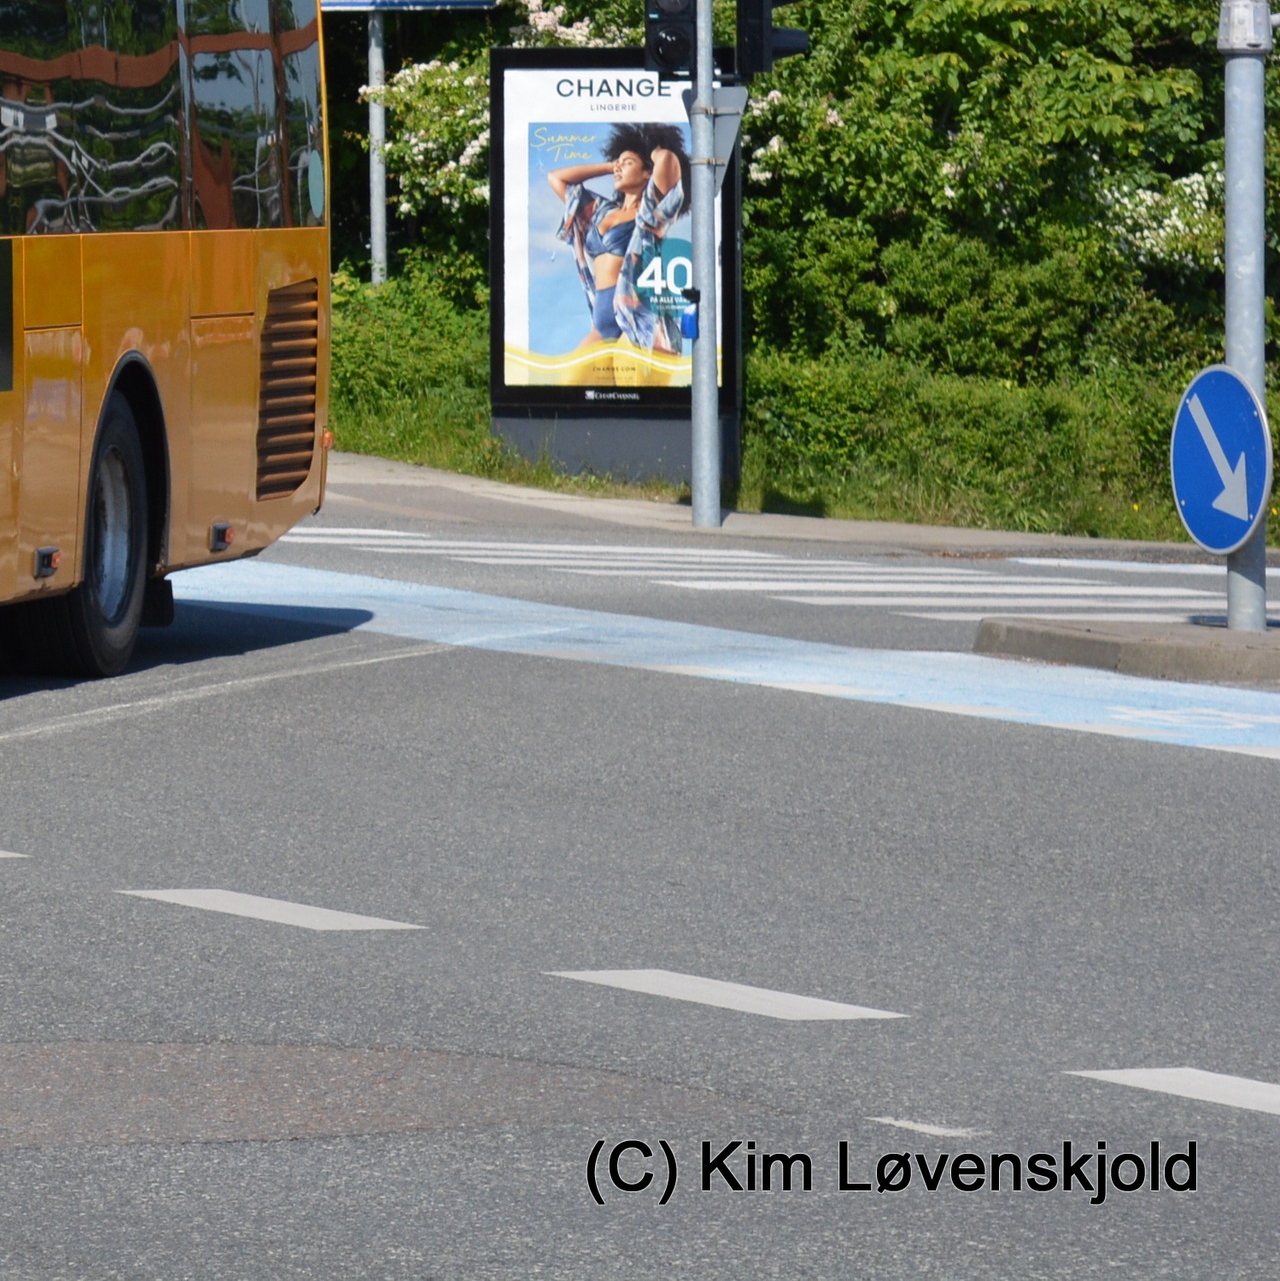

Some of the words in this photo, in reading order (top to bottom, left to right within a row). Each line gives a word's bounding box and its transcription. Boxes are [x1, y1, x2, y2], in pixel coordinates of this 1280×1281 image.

[556, 78, 672, 98] CHANGE
[590, 103, 638, 112] LINGERIE
[530, 126, 598, 148] Summer
[546, 142, 593, 163] Time
[636, 255, 693, 296] 40
